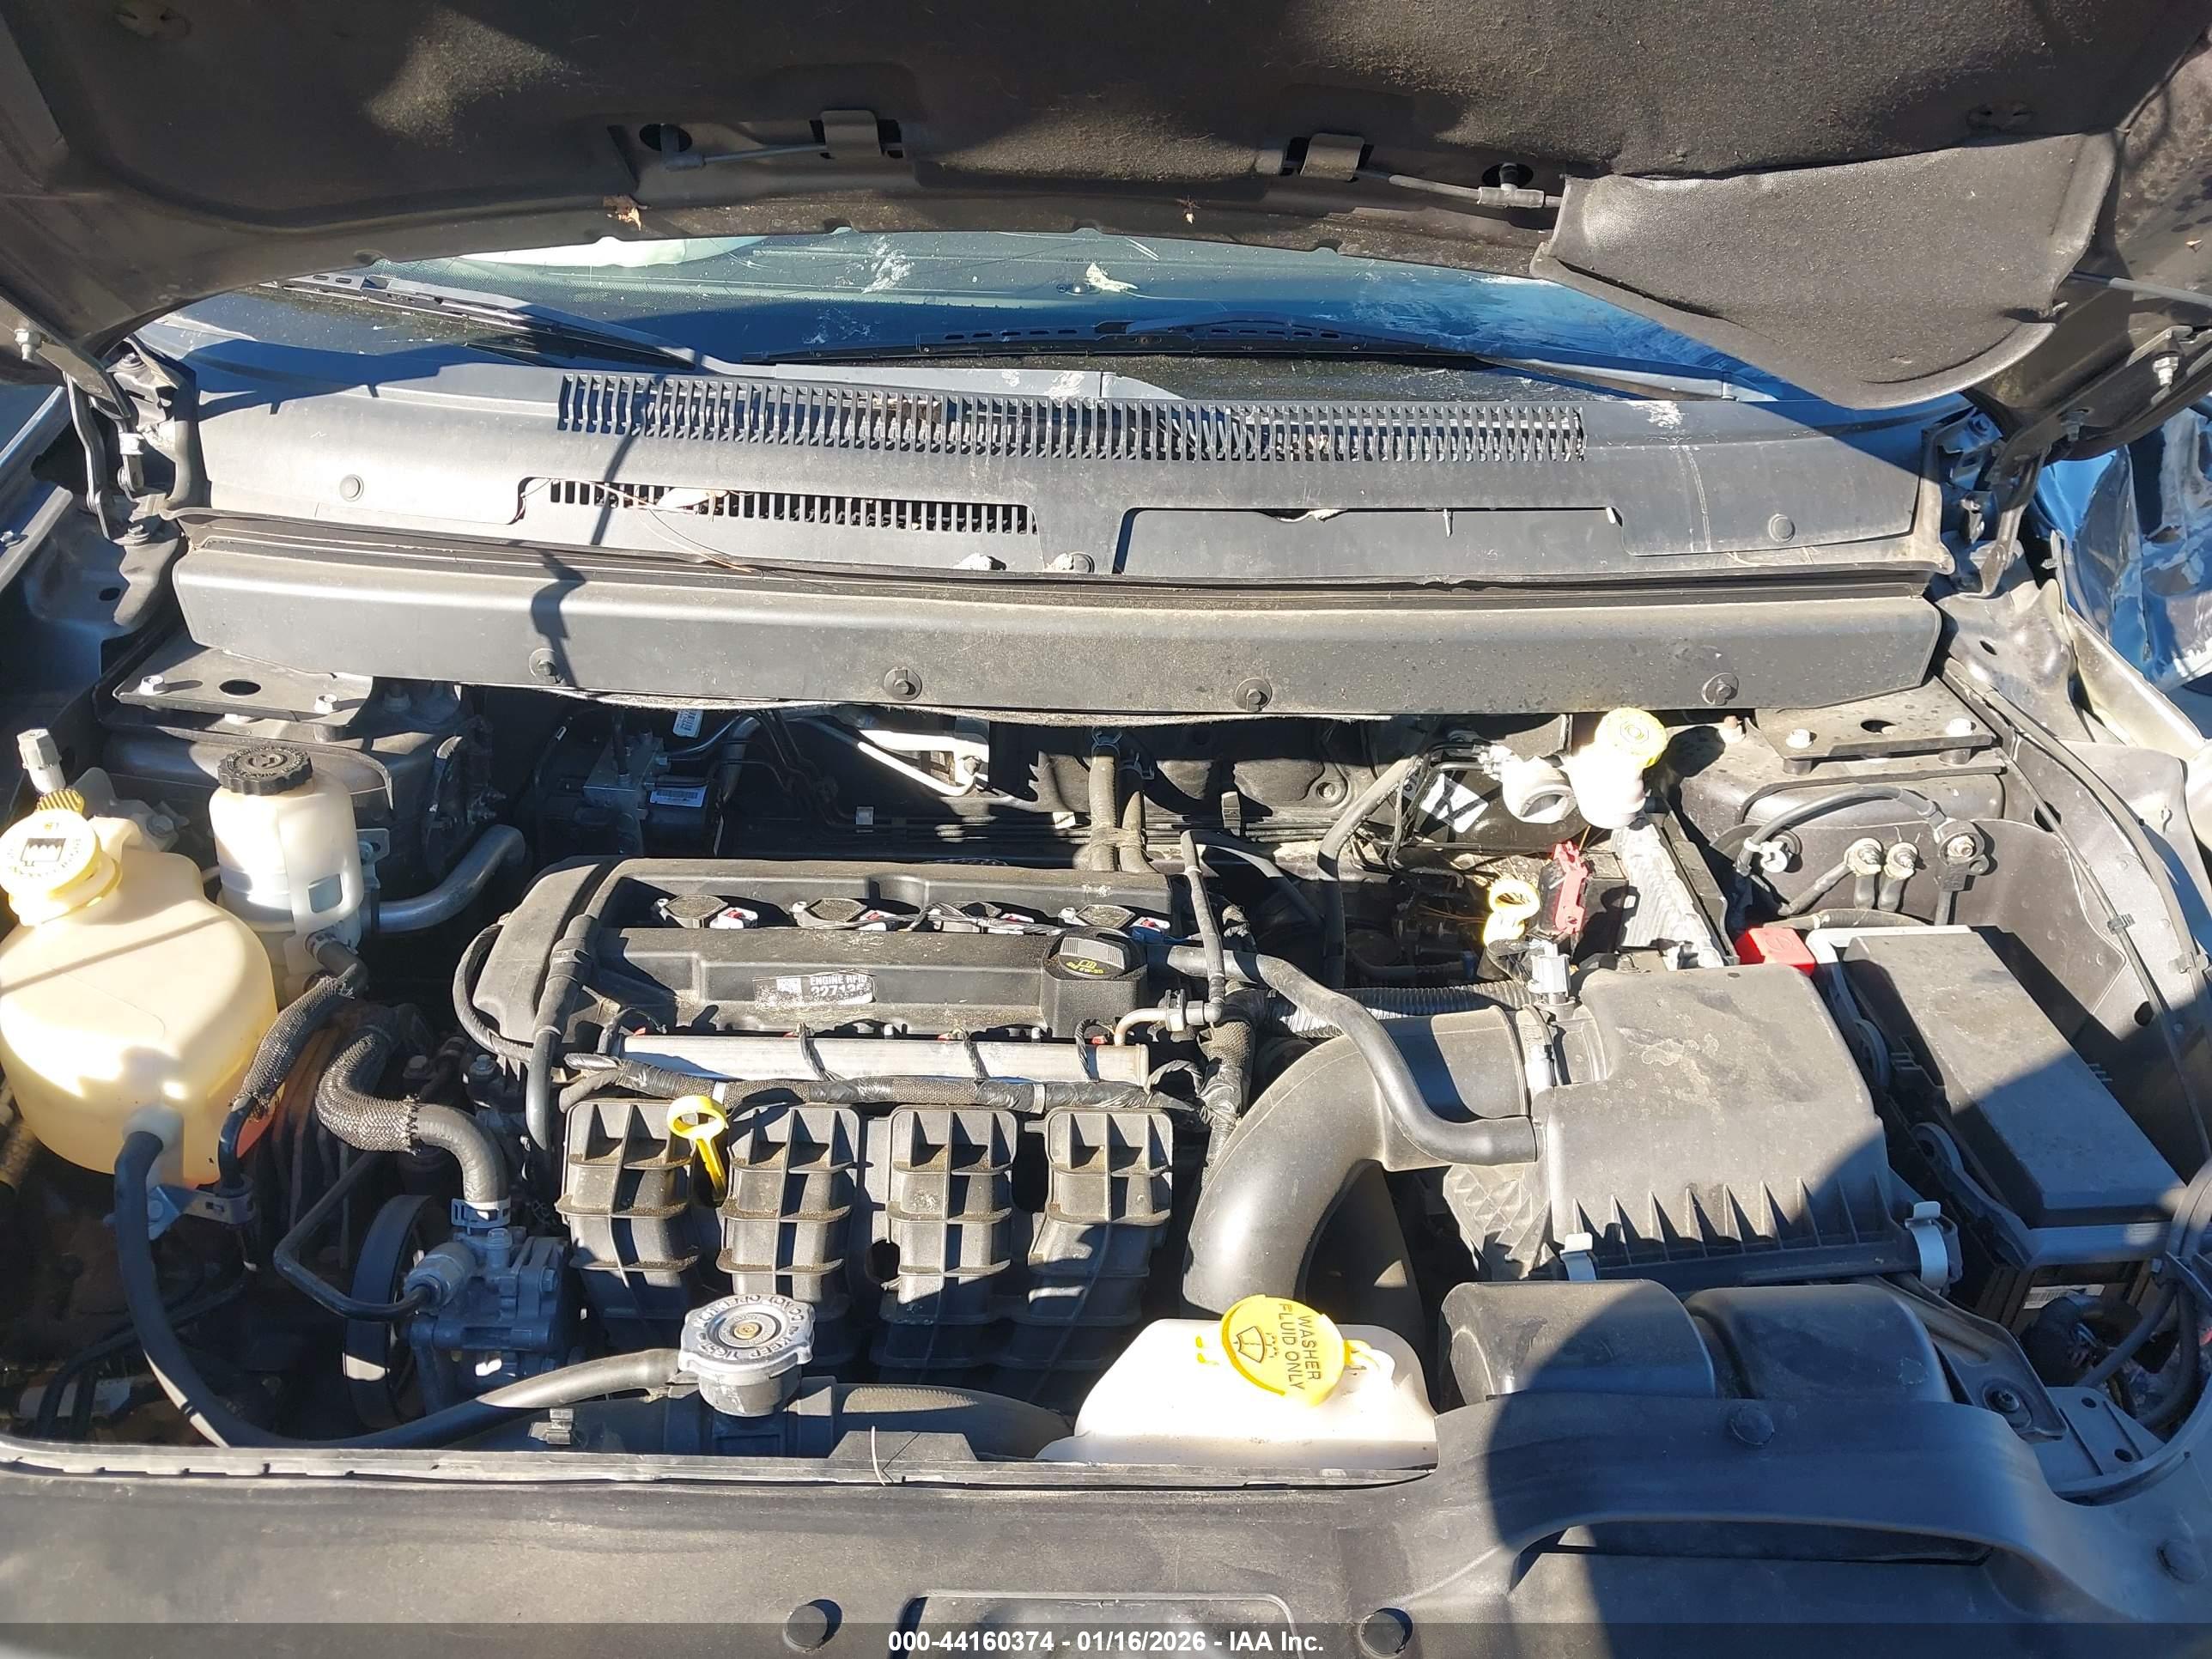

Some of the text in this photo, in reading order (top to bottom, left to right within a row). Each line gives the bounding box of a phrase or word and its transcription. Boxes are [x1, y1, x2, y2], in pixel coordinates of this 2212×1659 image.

[810, 974, 867, 986] ENGINE RFID
[750, 1336, 792, 1359] KEEP
[1279, 1303, 1305, 1390] FLUID ONLY
[1297, 1315, 1322, 1380] WASHER
